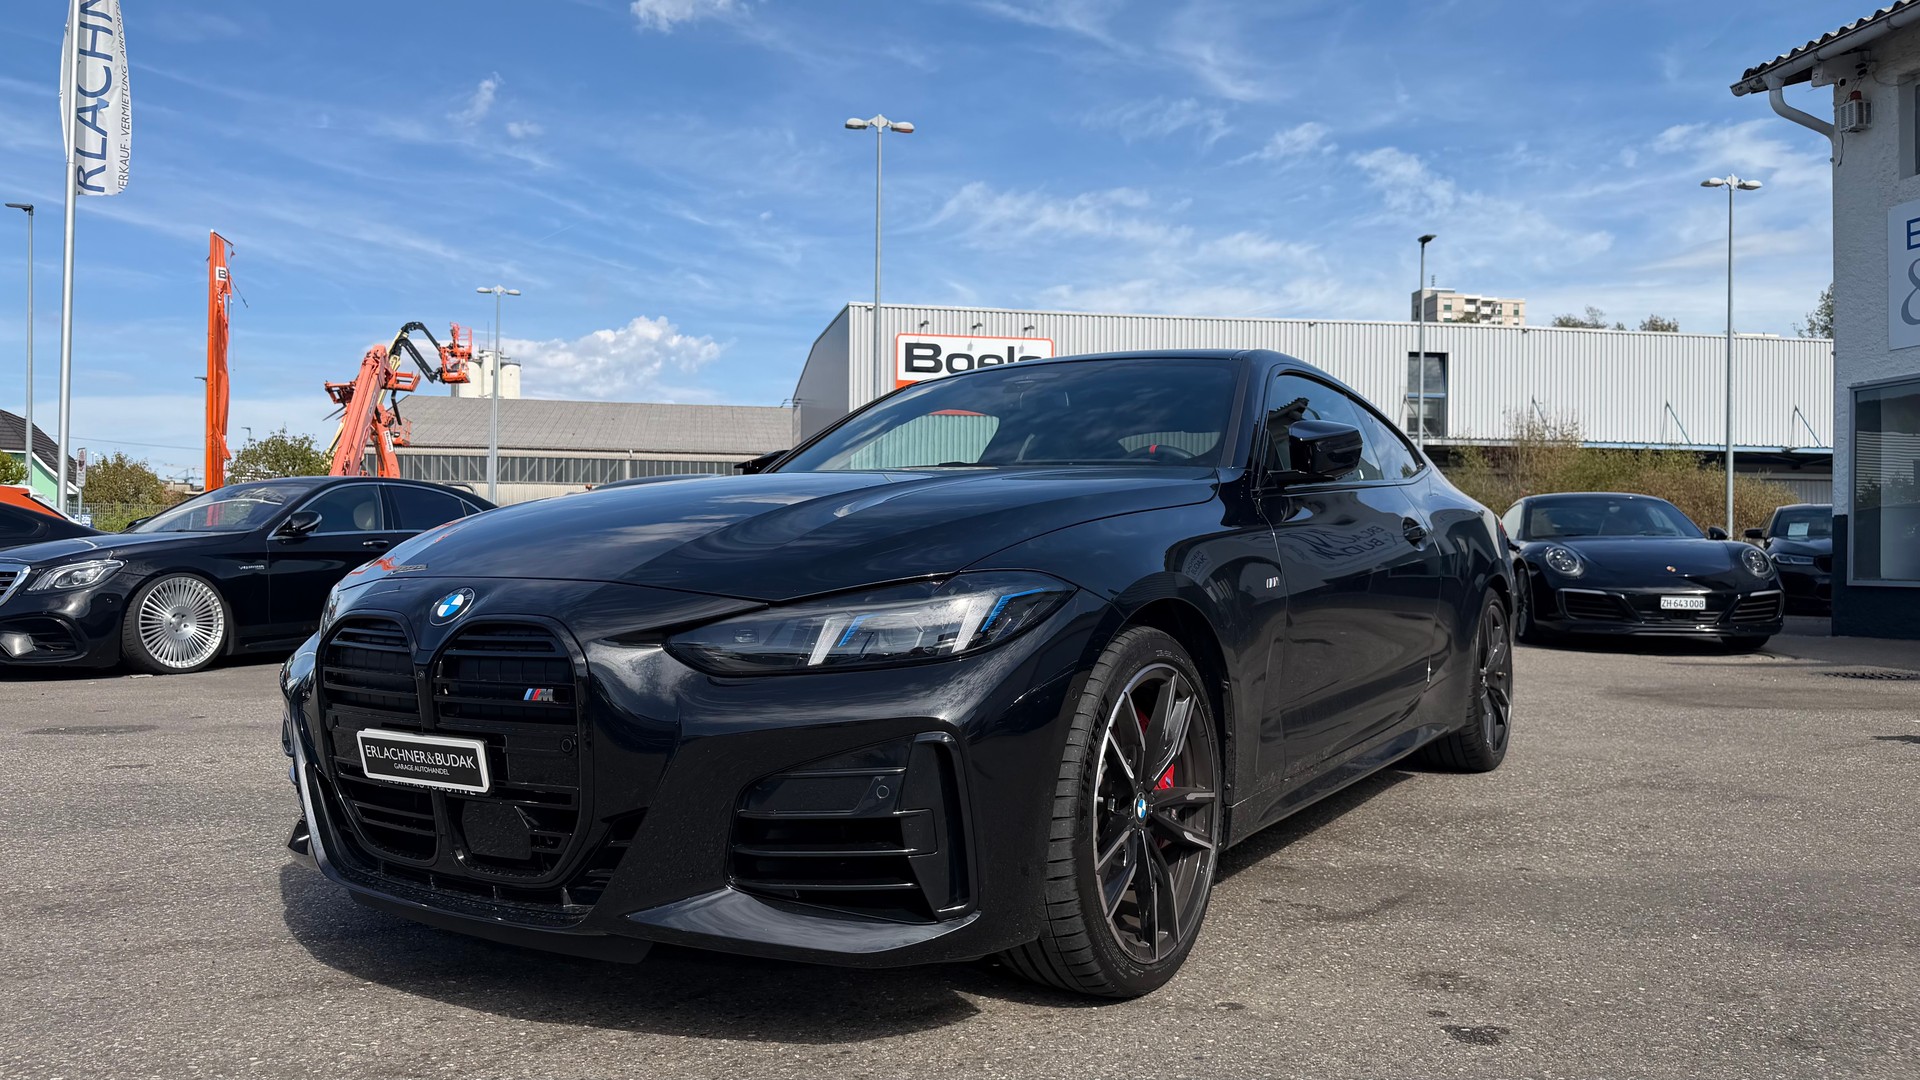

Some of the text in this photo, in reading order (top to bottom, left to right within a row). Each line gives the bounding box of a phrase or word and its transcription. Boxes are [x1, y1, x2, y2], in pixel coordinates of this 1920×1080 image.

[120, 64, 131, 136] VERMIETUNG
[1662, 599, 1672, 608] ZH
[393, 763, 450, 776] GARAGE AUTOHANDEL
